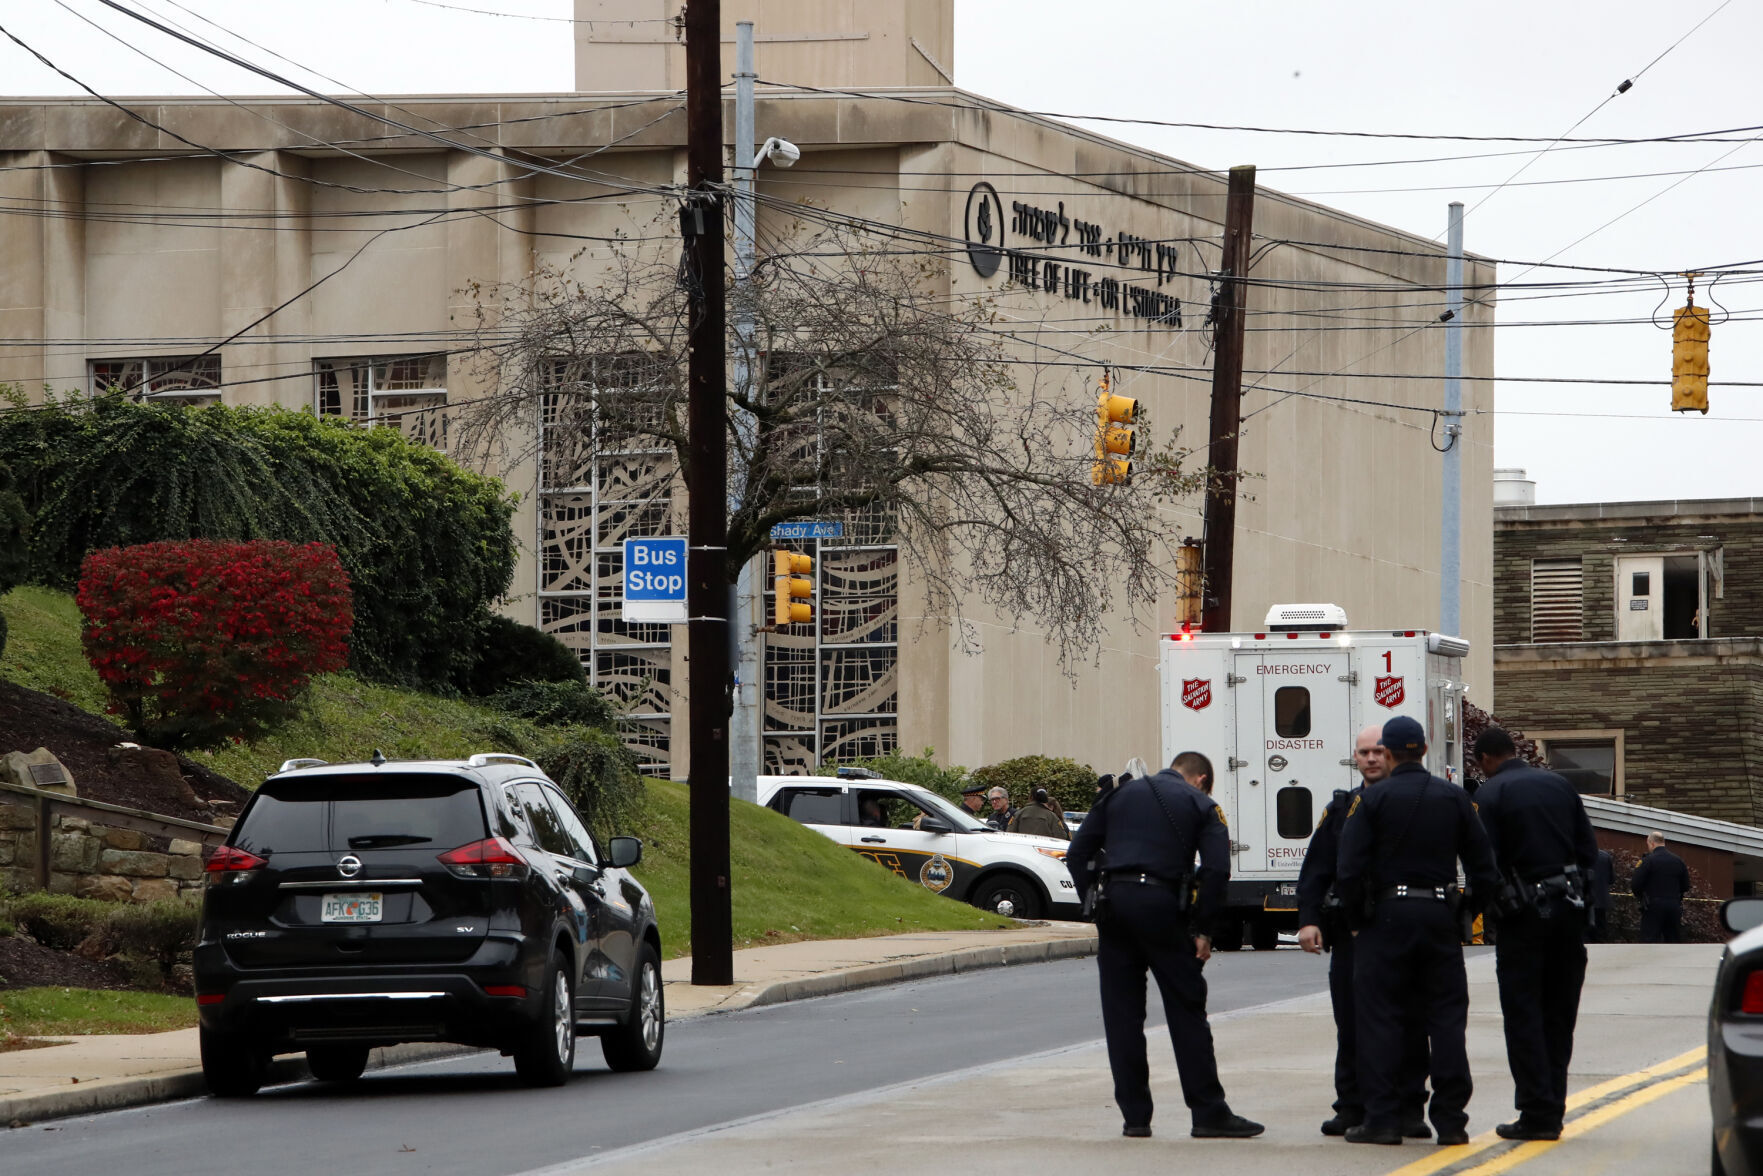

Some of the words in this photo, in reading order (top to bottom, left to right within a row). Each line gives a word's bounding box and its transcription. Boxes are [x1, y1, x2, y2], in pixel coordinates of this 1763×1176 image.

[1007, 253, 1040, 289] TREE
[1044, 261, 1061, 294] OF
[1065, 267, 1092, 303] LIFE
[1101, 277, 1119, 310] OR
[770, 524, 806, 537] Shady
[634, 545, 677, 565] Bus
[629, 570, 682, 594] Stop
[1382, 650, 1391, 672] 1
[1256, 664, 1331, 675] EMERGENCY
[1187, 681, 1198, 692] THE
[1376, 680, 1402, 700] SALVATION
[1380, 678, 1391, 689] THE
[1183, 682, 1208, 703] SALVATION
[1192, 692, 1208, 707] ARMY
[1385, 689, 1401, 705] ARMY
[1266, 739, 1324, 750] DISASTER
[226, 931, 266, 940] ROGUE
